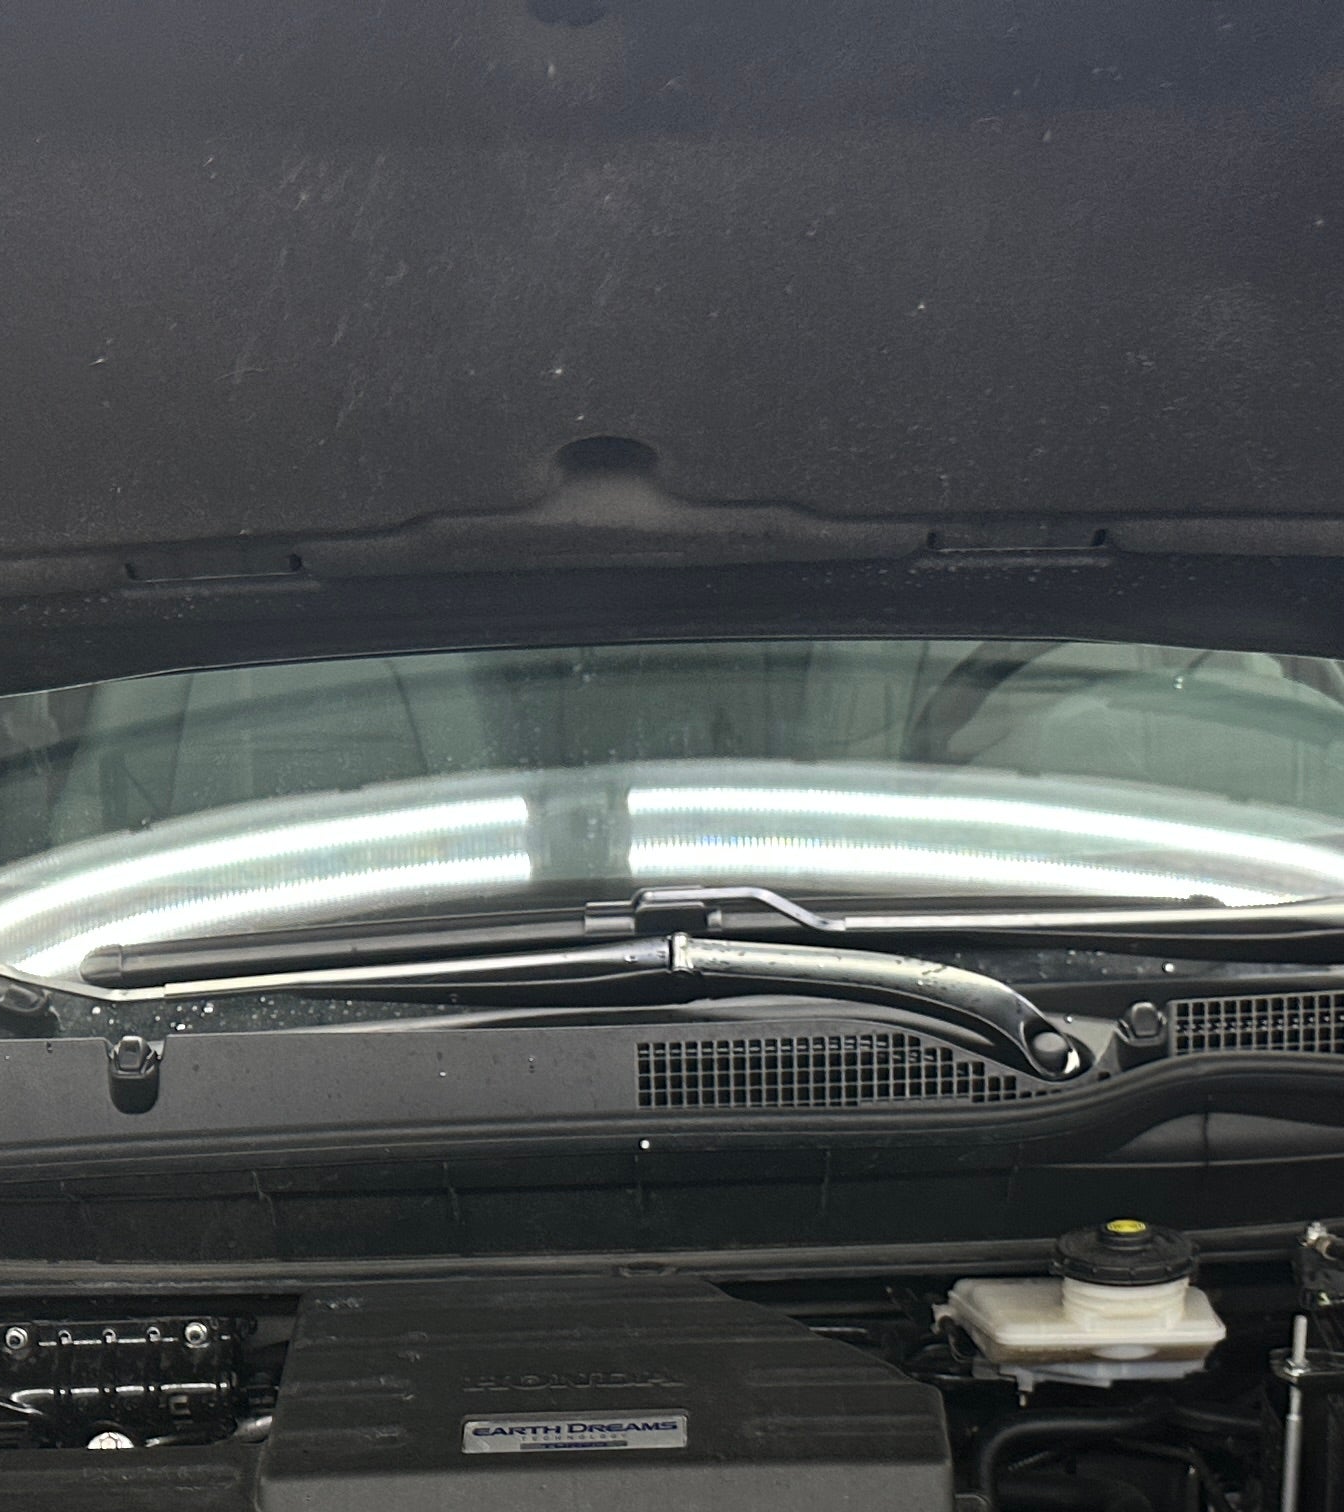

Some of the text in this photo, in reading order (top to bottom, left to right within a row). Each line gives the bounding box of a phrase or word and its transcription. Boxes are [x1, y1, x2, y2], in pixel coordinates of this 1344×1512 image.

[472, 1421, 678, 1437] EARTH DREAMS
[521, 1433, 627, 1442] TECHNOLOGY
